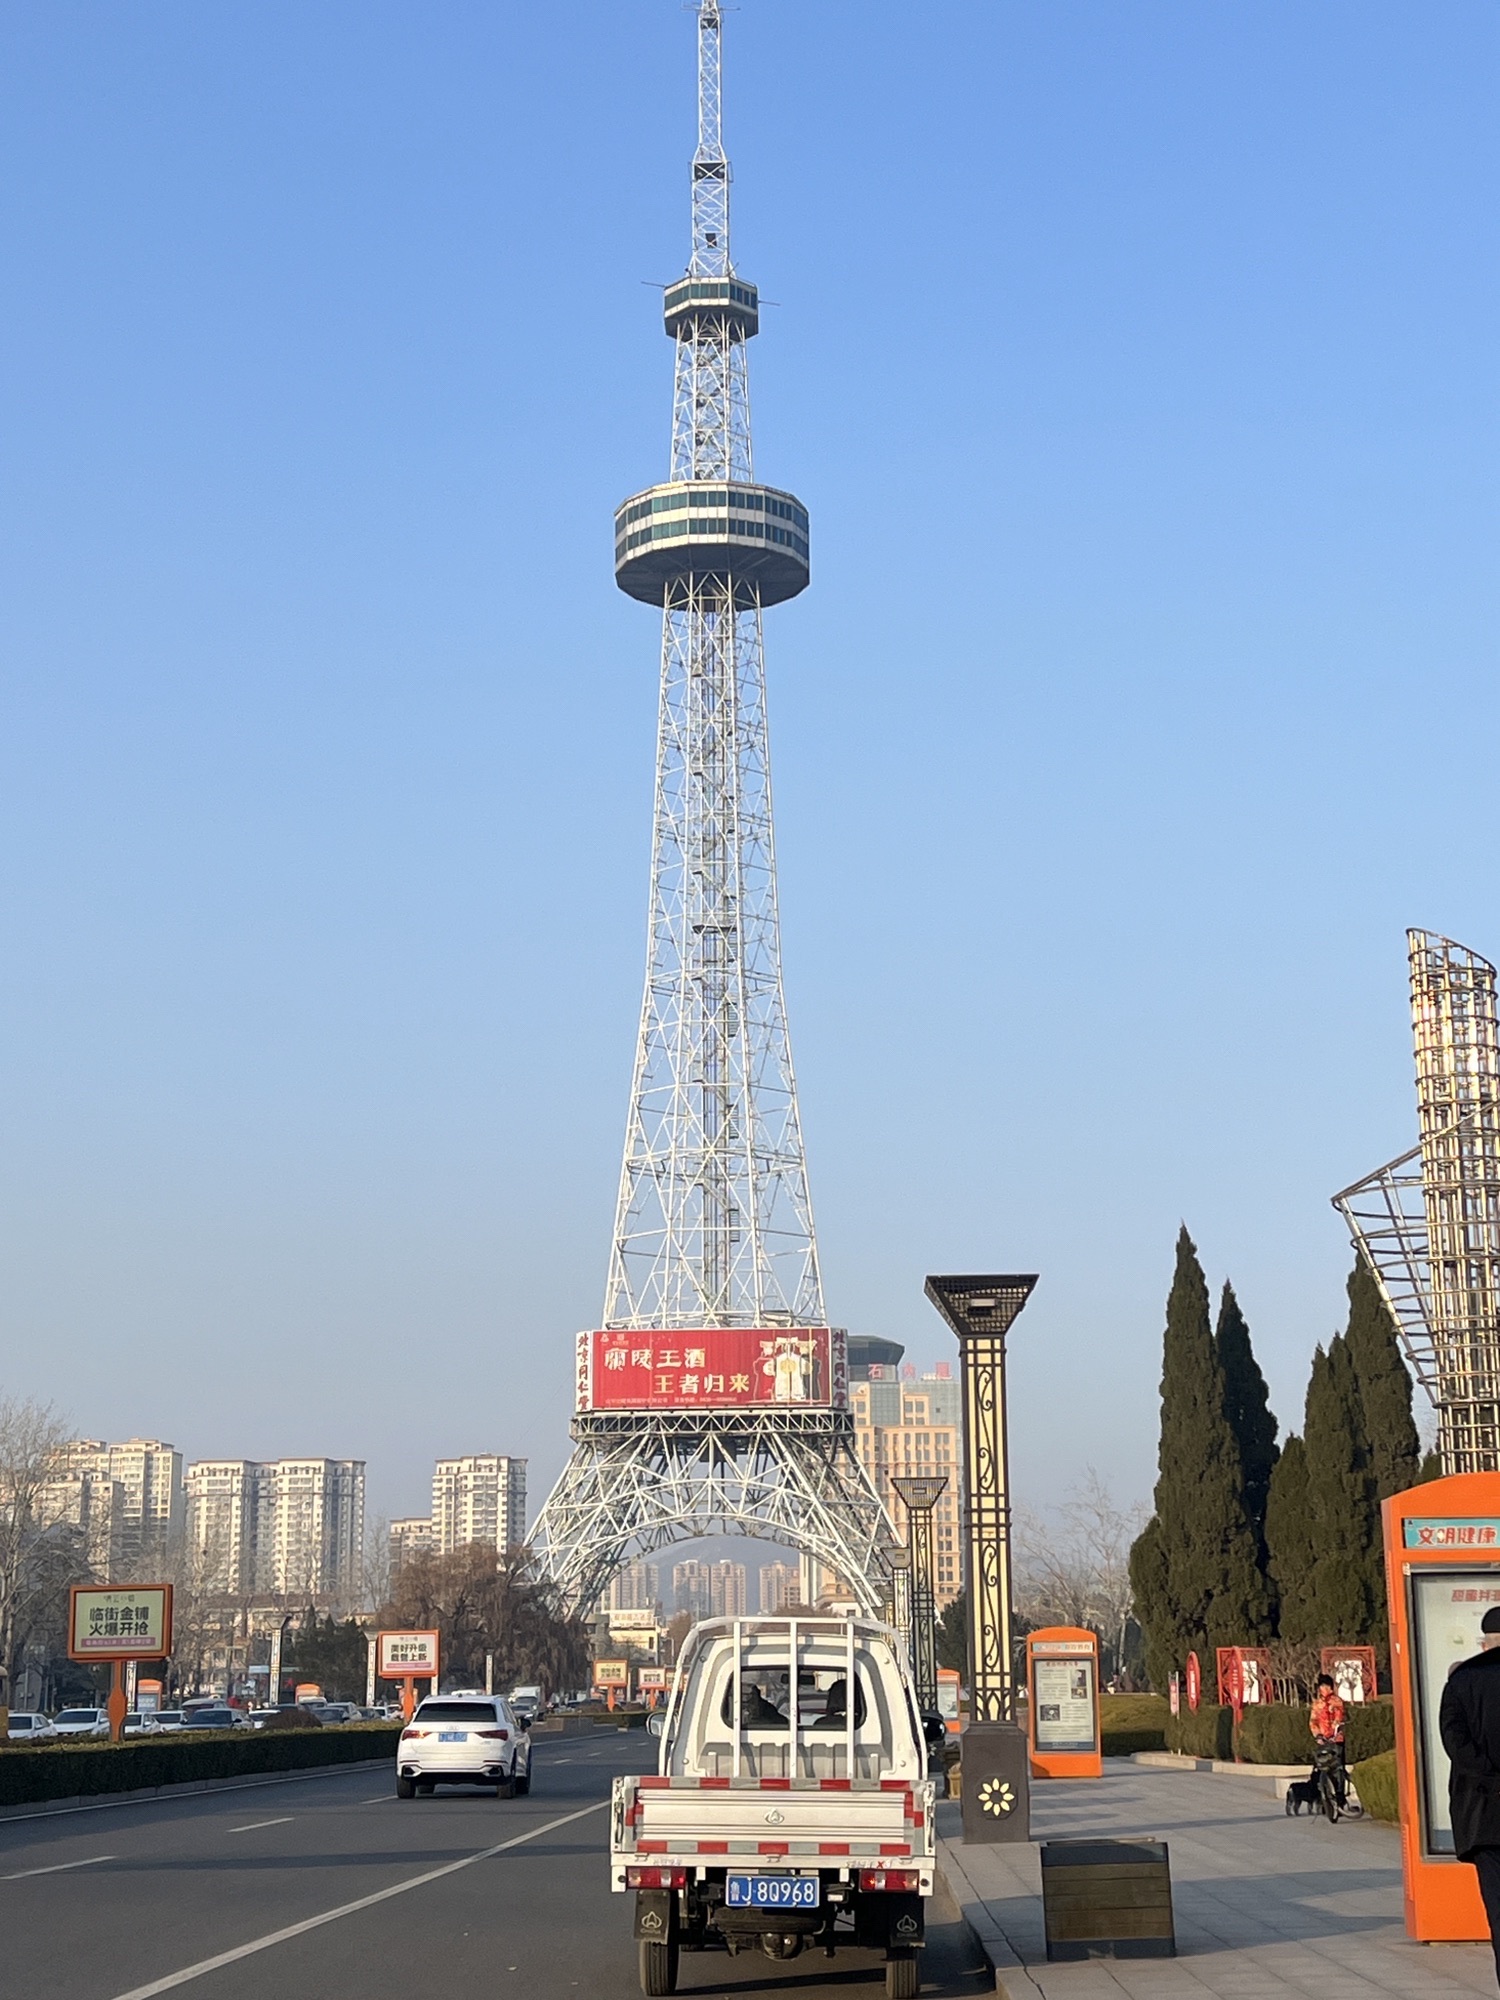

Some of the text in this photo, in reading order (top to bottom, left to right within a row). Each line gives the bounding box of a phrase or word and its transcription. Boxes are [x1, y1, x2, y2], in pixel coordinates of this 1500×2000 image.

[653, 1373, 750, 1395] 王者归来
[1417, 1527, 1497, 1545] 文明健康
[89, 1606, 150, 1621] 临街金铺
[89, 1621, 149, 1636] 火爆开抢
